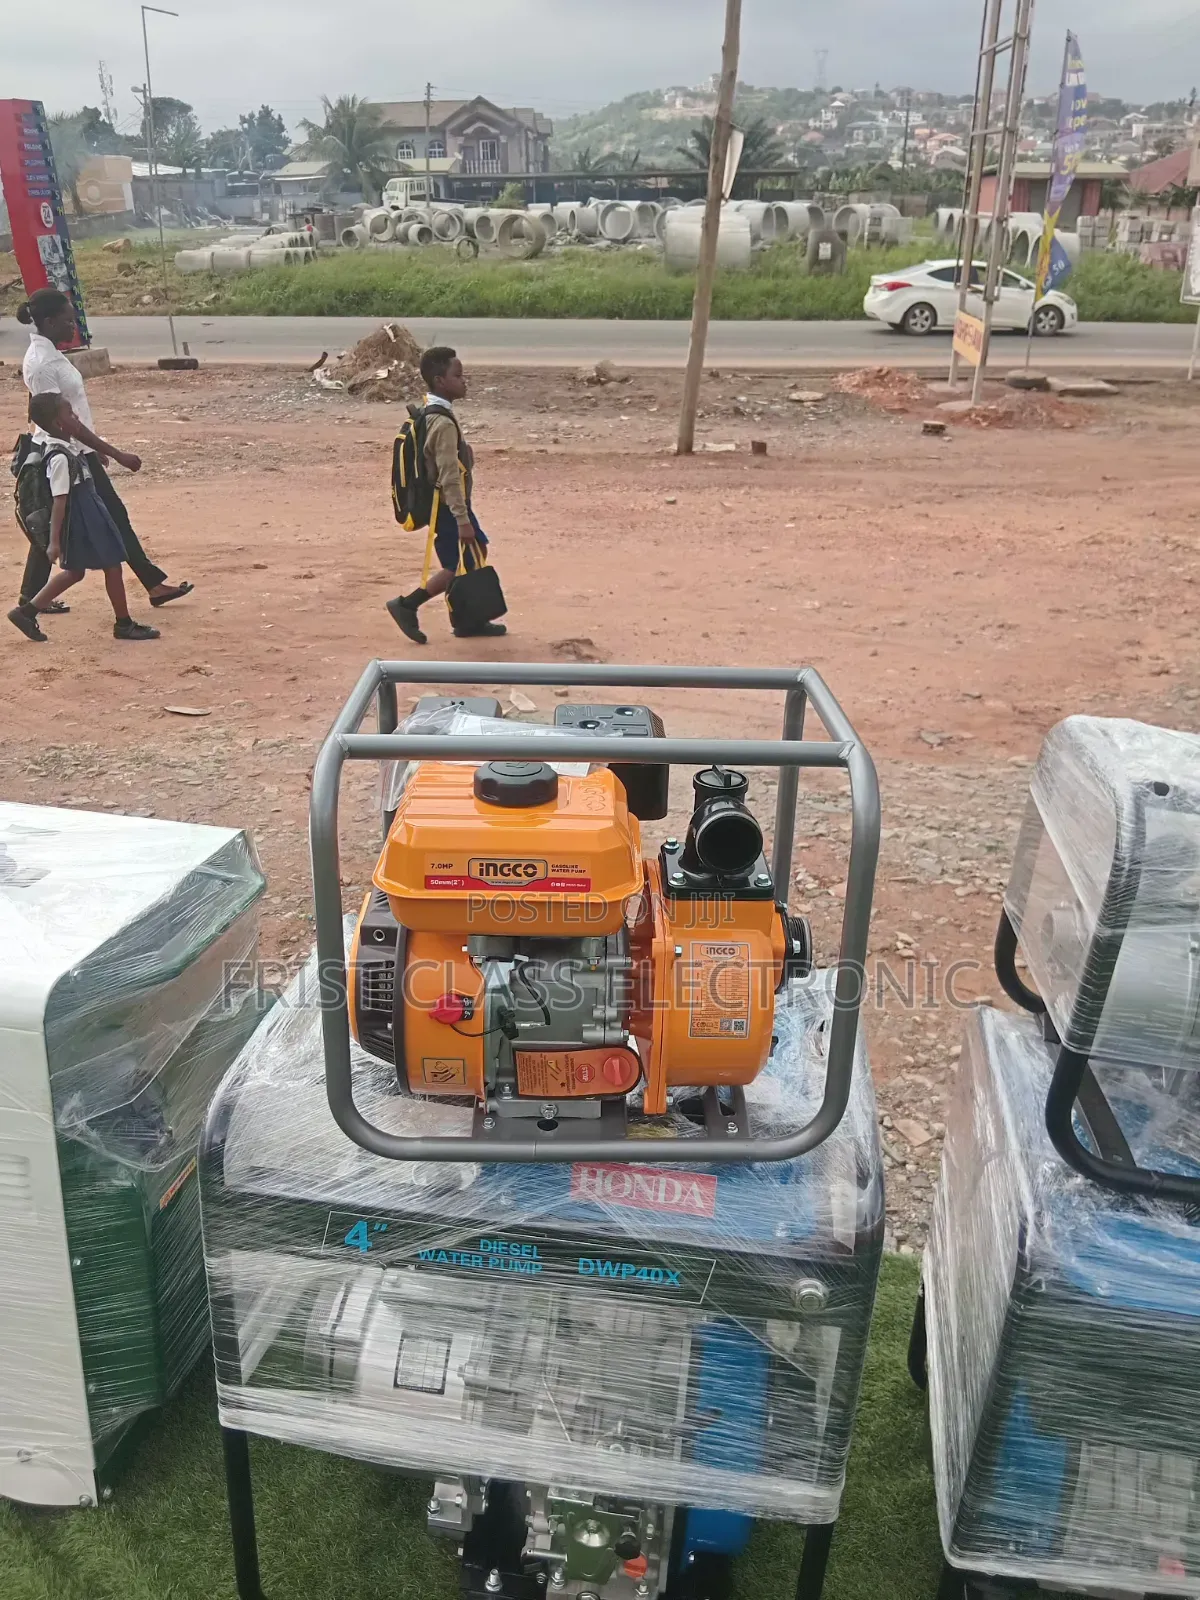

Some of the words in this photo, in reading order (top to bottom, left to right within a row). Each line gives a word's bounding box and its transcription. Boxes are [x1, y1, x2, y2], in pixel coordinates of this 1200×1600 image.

[581, 1066, 589, 1081] STOP
[580, 1166, 706, 1210] HONDA
[418, 1249, 484, 1268] WATER
[487, 1257, 543, 1275] PUMP
[479, 1239, 542, 1259] DIESEL
[577, 1258, 682, 1288] DWP40X
